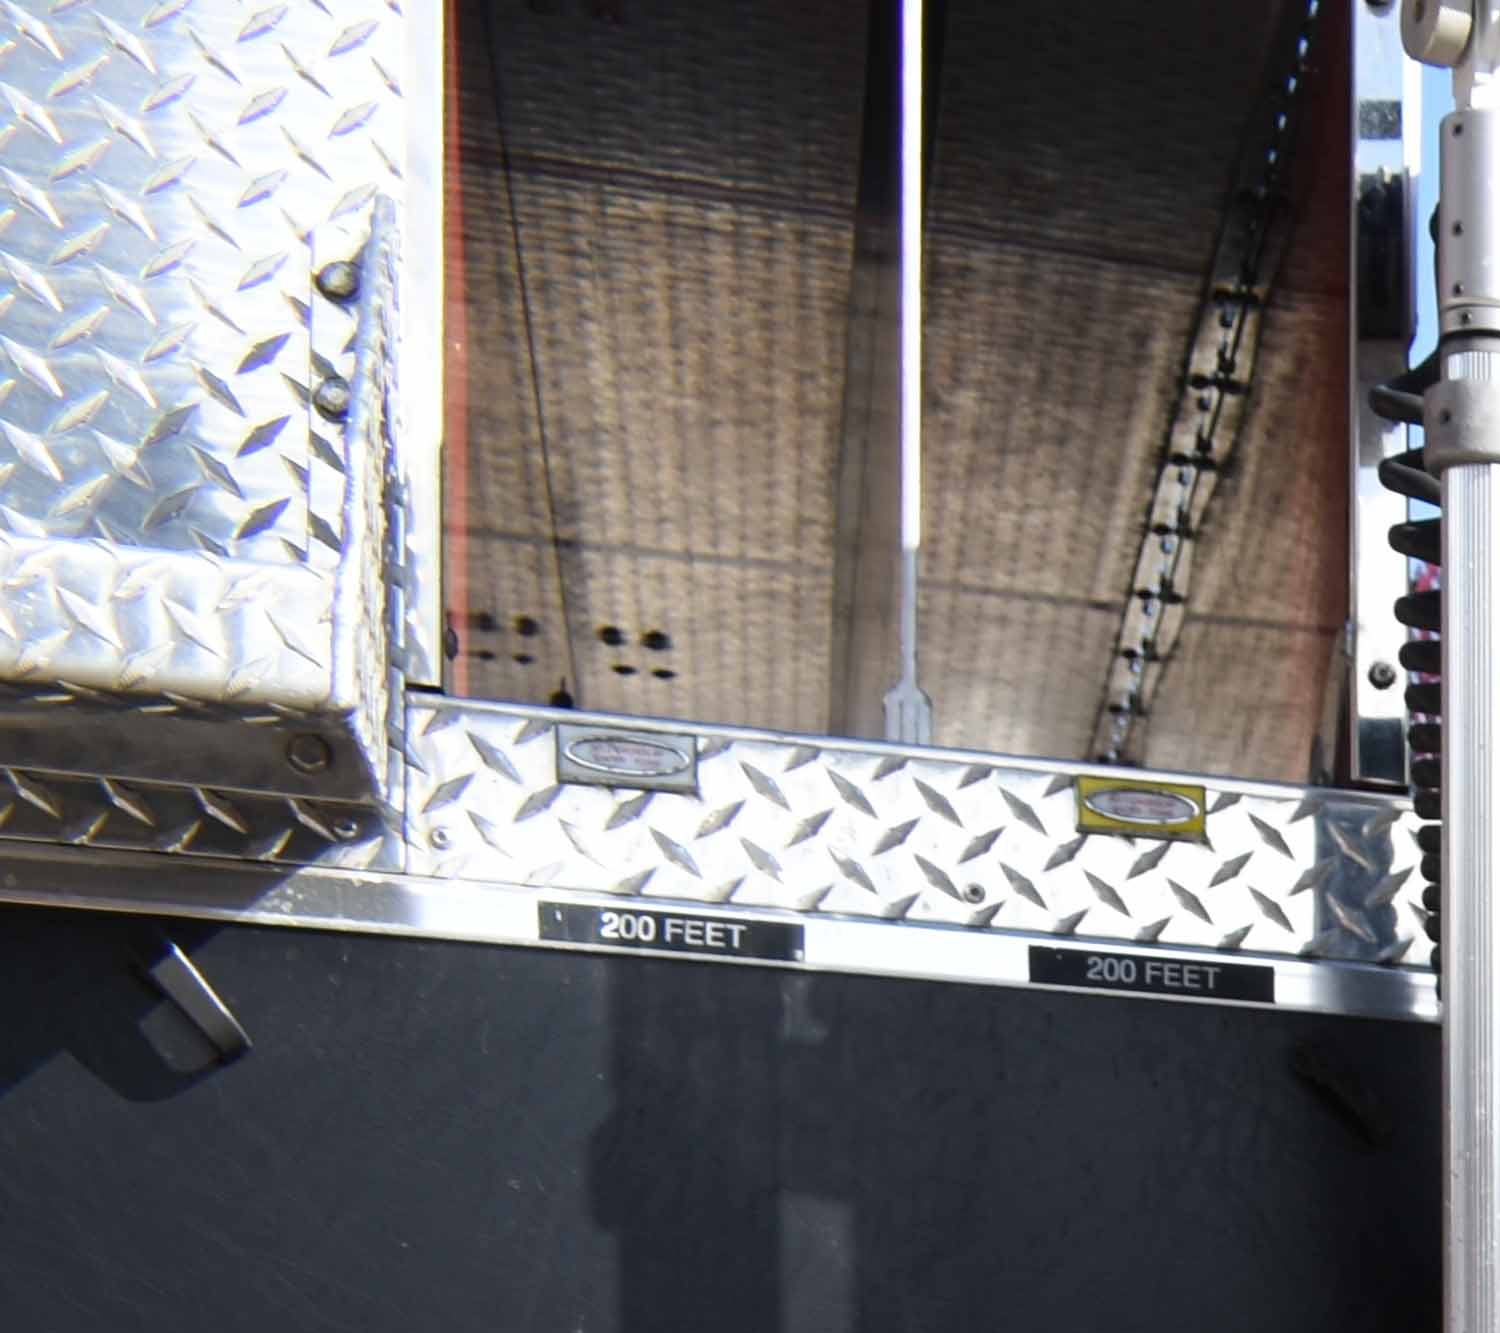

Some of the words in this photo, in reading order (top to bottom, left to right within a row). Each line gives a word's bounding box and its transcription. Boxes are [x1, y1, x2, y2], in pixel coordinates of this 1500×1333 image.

[599, 912, 656, 944] 200
[662, 919, 749, 949] FEET
[1085, 956, 1138, 984] 200
[1144, 960, 1221, 990] FEET
